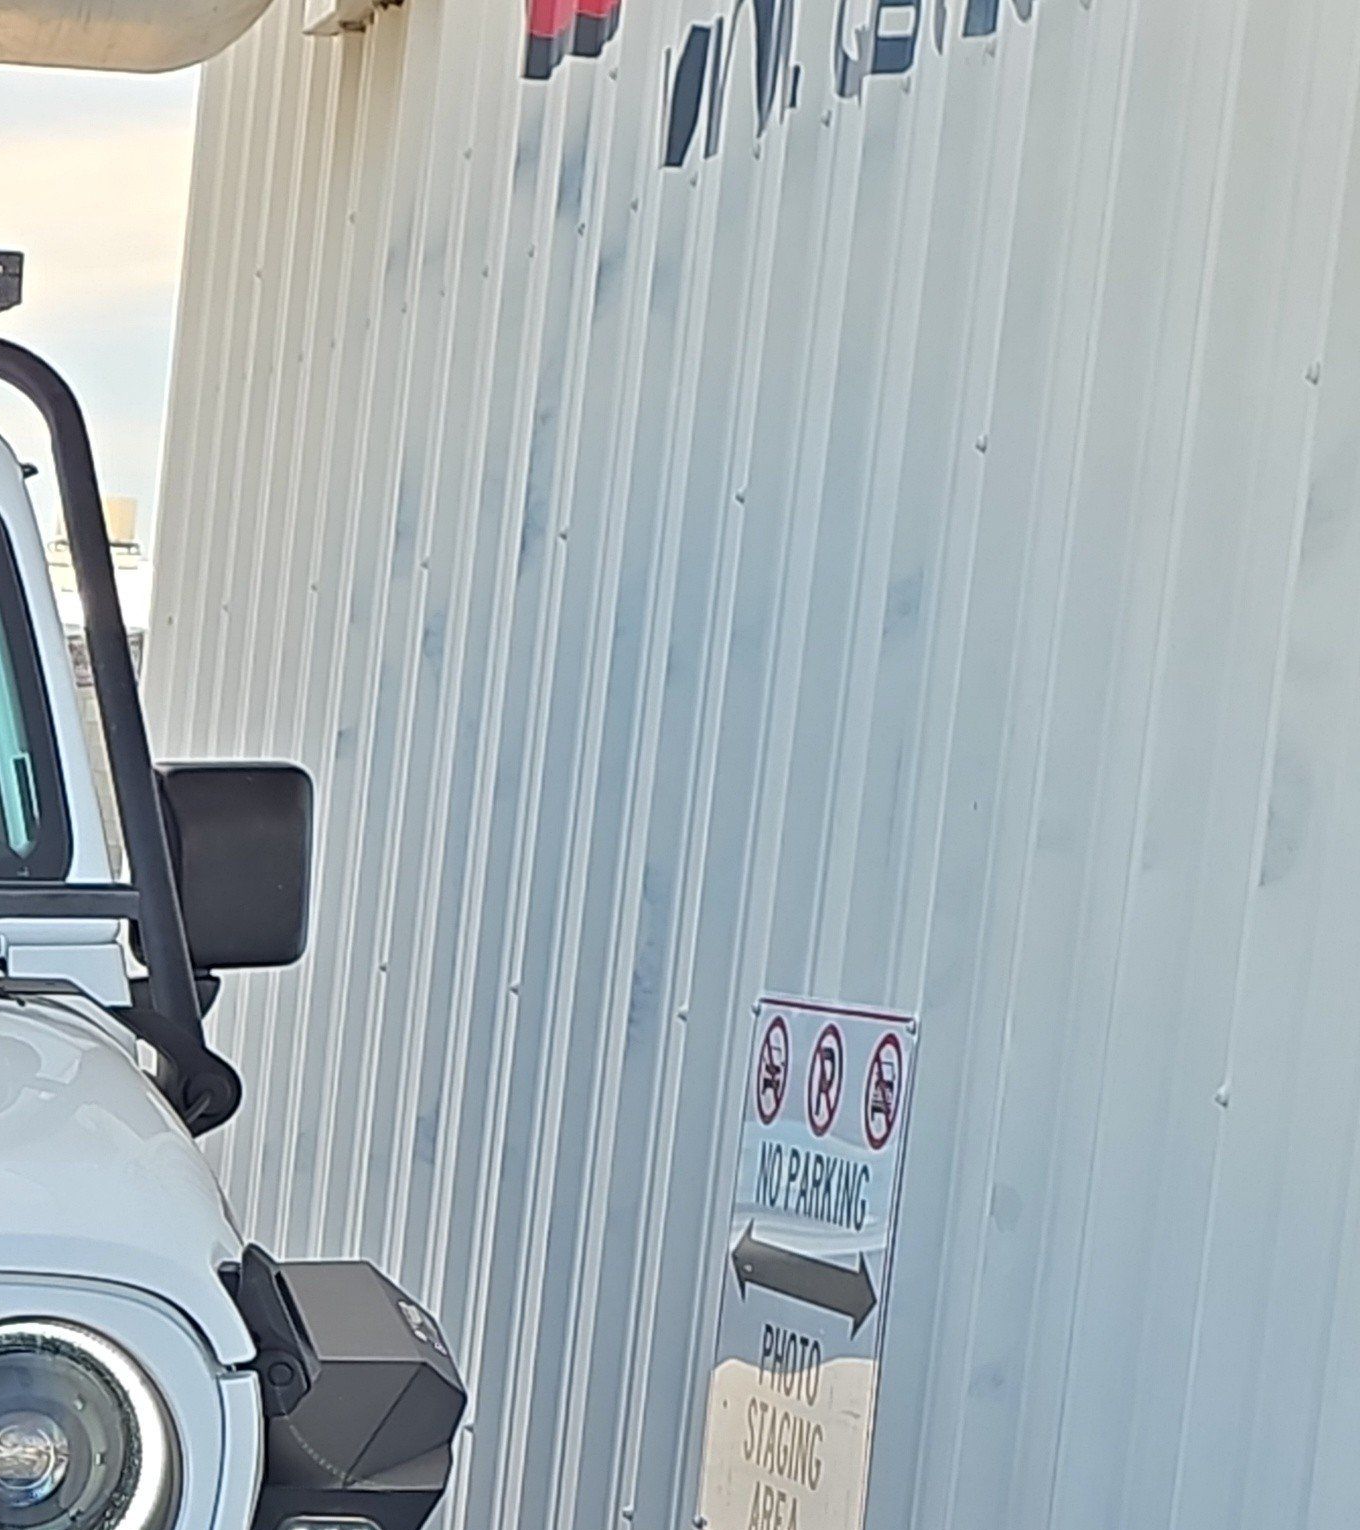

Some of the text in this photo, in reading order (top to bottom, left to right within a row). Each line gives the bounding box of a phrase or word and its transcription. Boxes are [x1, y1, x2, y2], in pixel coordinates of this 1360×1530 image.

[755, 1140, 870, 1231] NO PARKING
[758, 1323, 822, 1407] PHOTO
[743, 1397, 824, 1491] STAGING
